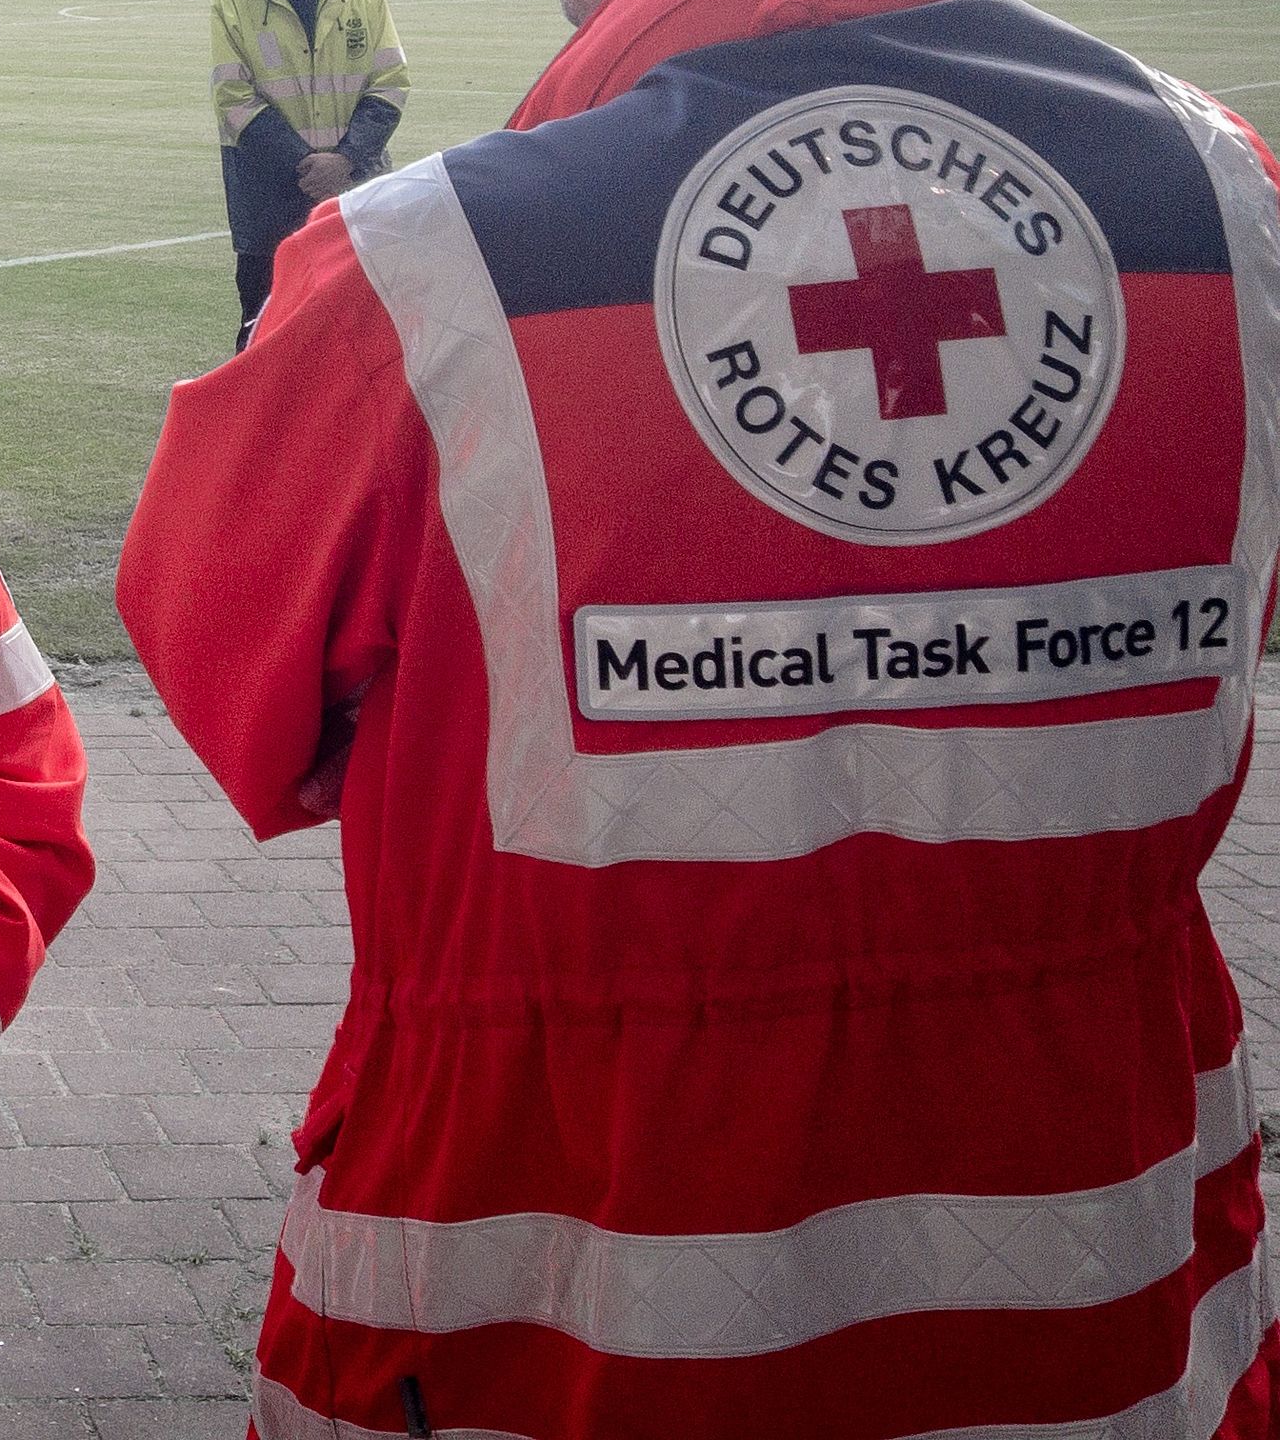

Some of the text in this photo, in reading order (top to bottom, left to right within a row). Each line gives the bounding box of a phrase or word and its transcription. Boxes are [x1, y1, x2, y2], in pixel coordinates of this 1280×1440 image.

[700, 119, 1063, 271] DEUTSCHES
[706, 309, 1093, 510] ROTES KREUZ
[596, 597, 1229, 691] Medical Task Force 12
